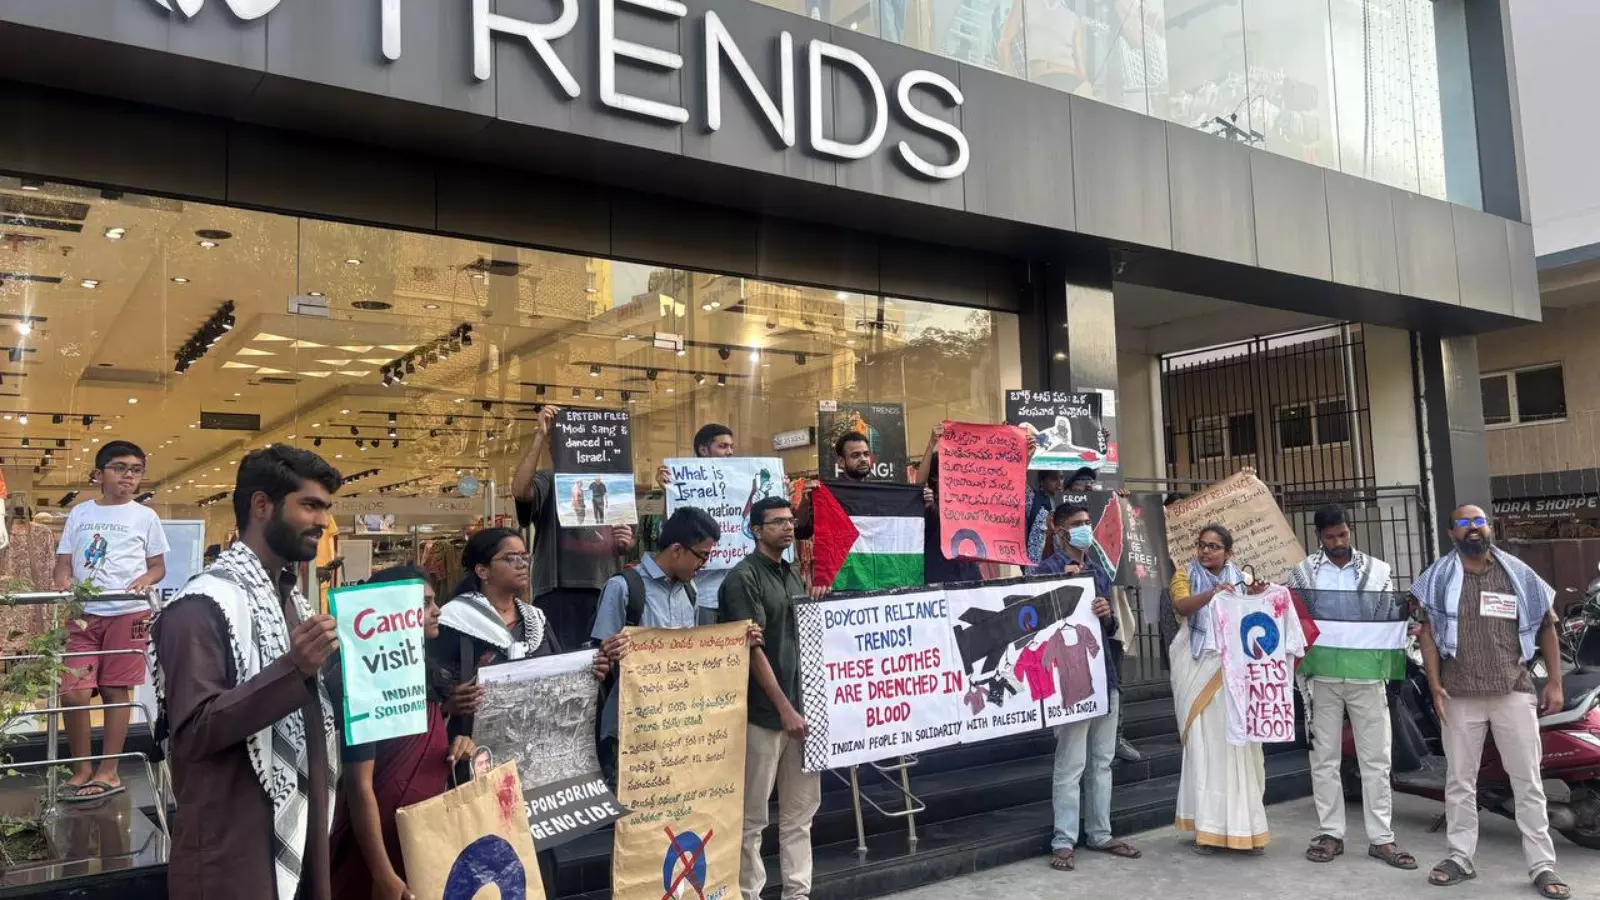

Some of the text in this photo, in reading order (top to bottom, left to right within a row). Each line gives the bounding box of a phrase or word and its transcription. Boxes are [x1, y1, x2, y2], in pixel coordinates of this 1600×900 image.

[567, 411, 602, 421] EPSTEIN
[872, 406, 900, 415] TRENDS
[565, 437, 614, 448] danced in
[671, 465, 724, 481] What is
[674, 482, 727, 501] Israel?
[1063, 494, 1088, 503] FROM
[1173, 493, 1211, 518] BOYCOTT
[1211, 476, 1256, 500] RELIANCE
[1535, 496, 1597, 511] SHOPPE
[709, 543, 749, 563] project
[1128, 552, 1157, 565] FREE!
[824, 599, 947, 629] BOYCOTT RELIANCE
[855, 625, 912, 651] TRENDS!
[362, 638, 419, 674] visit
[825, 647, 941, 681] THESE CLOTHES
[382, 685, 424, 702] INDIAN
[834, 670, 963, 704] ARE DRENCHED IN
[1249, 681, 1288, 702] NOT
[866, 702, 911, 728] BLOOD
[831, 701, 1098, 756] INDIAN PEOPLE IN SOLIDARITY WITH PALESTINE BDS IN INDIA
[523, 779, 609, 818] SPONSORING
[530, 801, 620, 840] GENOCIDE
